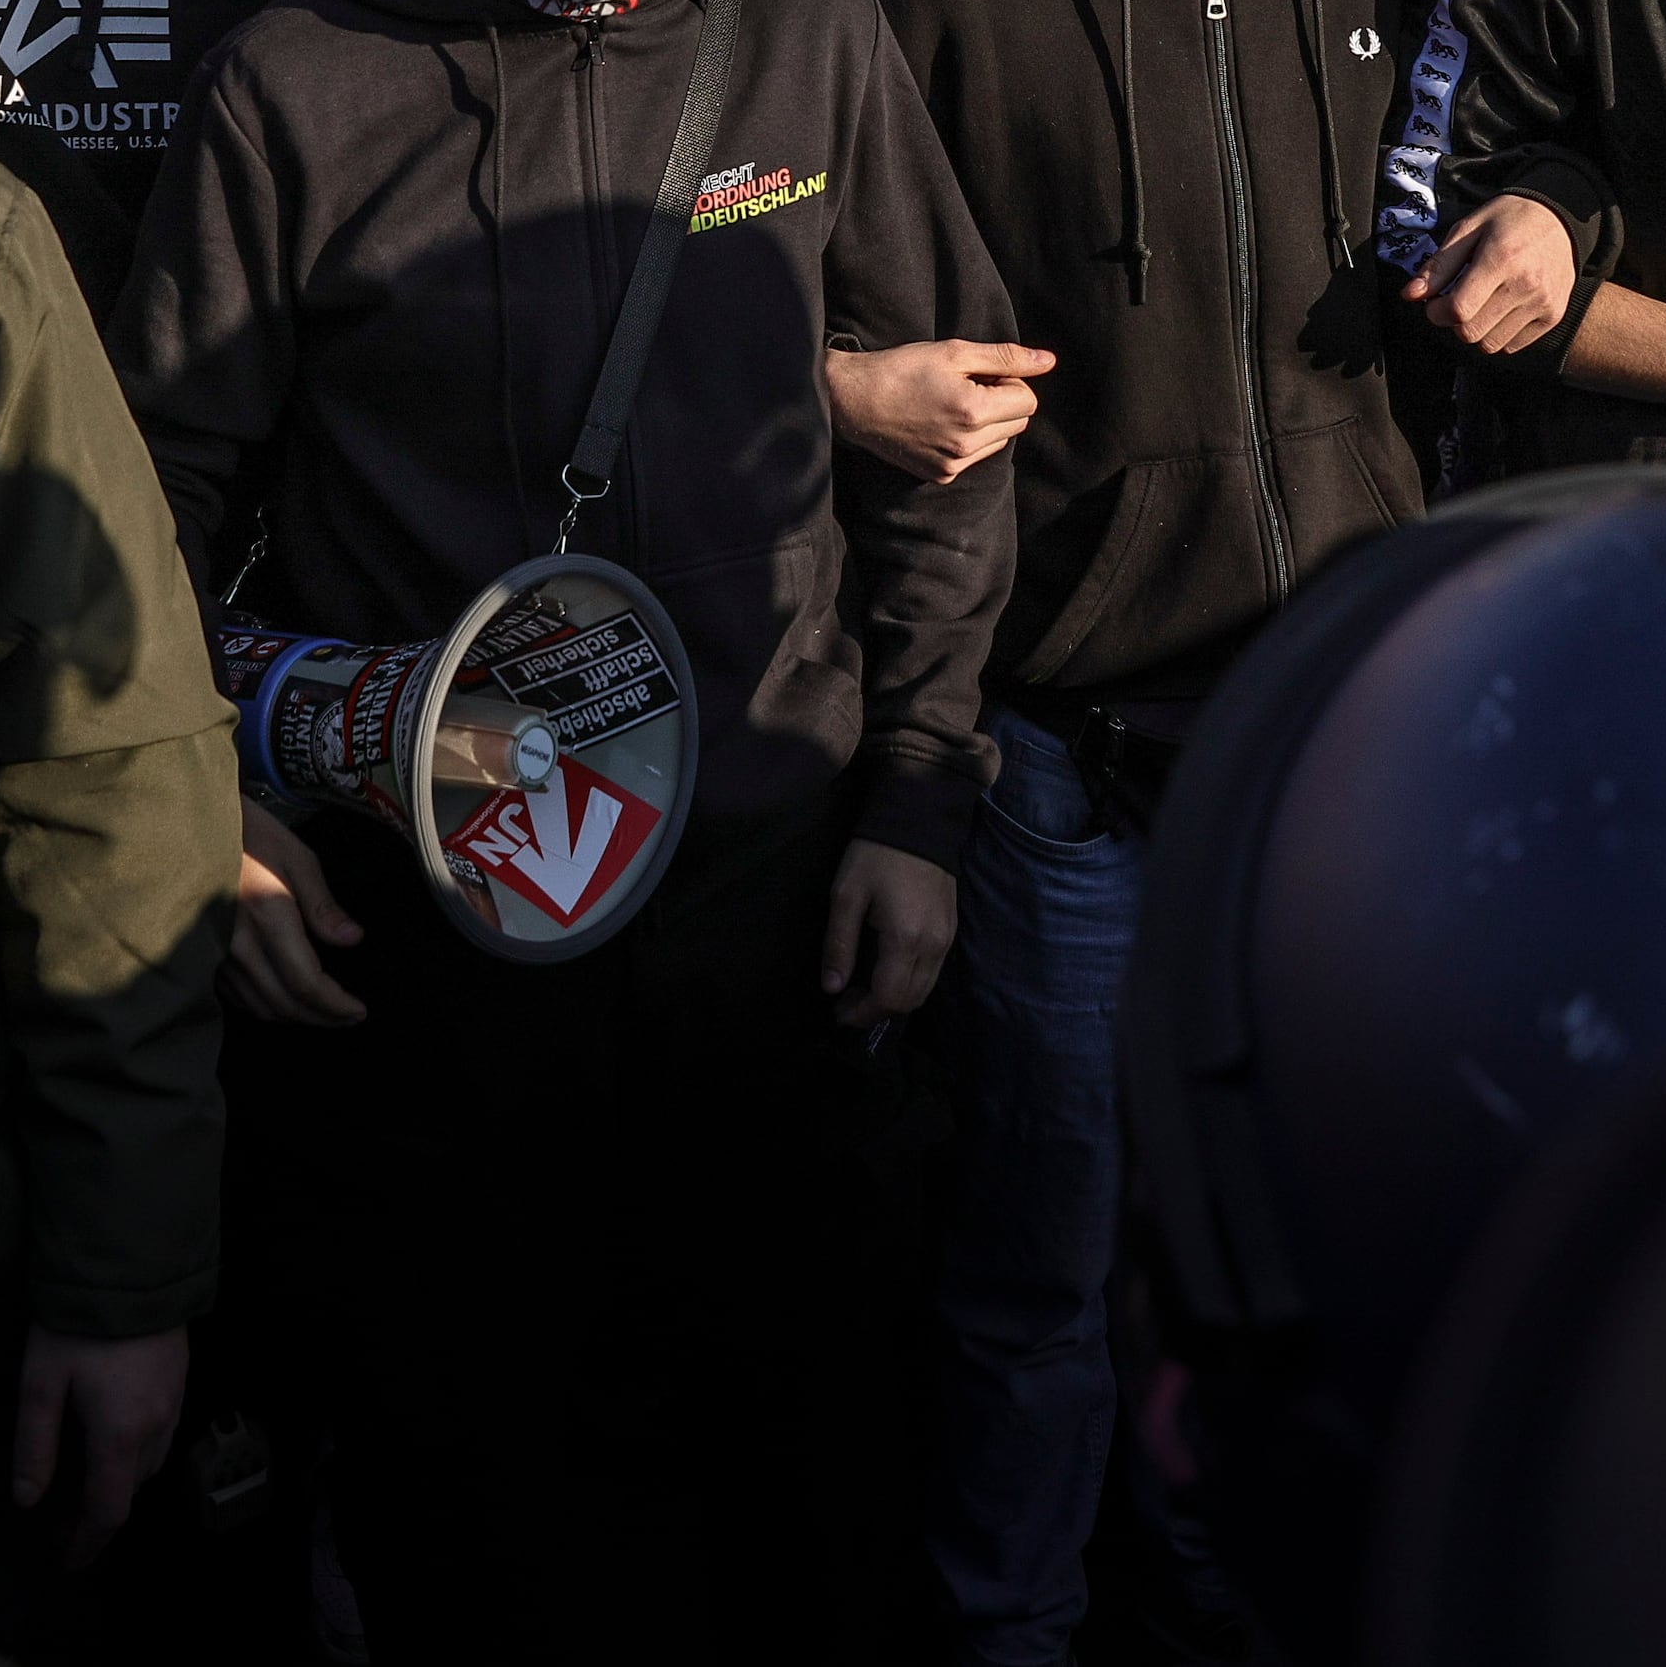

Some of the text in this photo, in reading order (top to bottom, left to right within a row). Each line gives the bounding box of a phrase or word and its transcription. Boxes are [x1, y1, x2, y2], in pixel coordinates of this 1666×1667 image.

[697, 167, 791, 212] ORDNUNG
[517, 629, 620, 682] sicherheit
[579, 645, 654, 694] schafft
[367, 664, 406, 761] ANIMALS
[467, 803, 530, 867] JN
